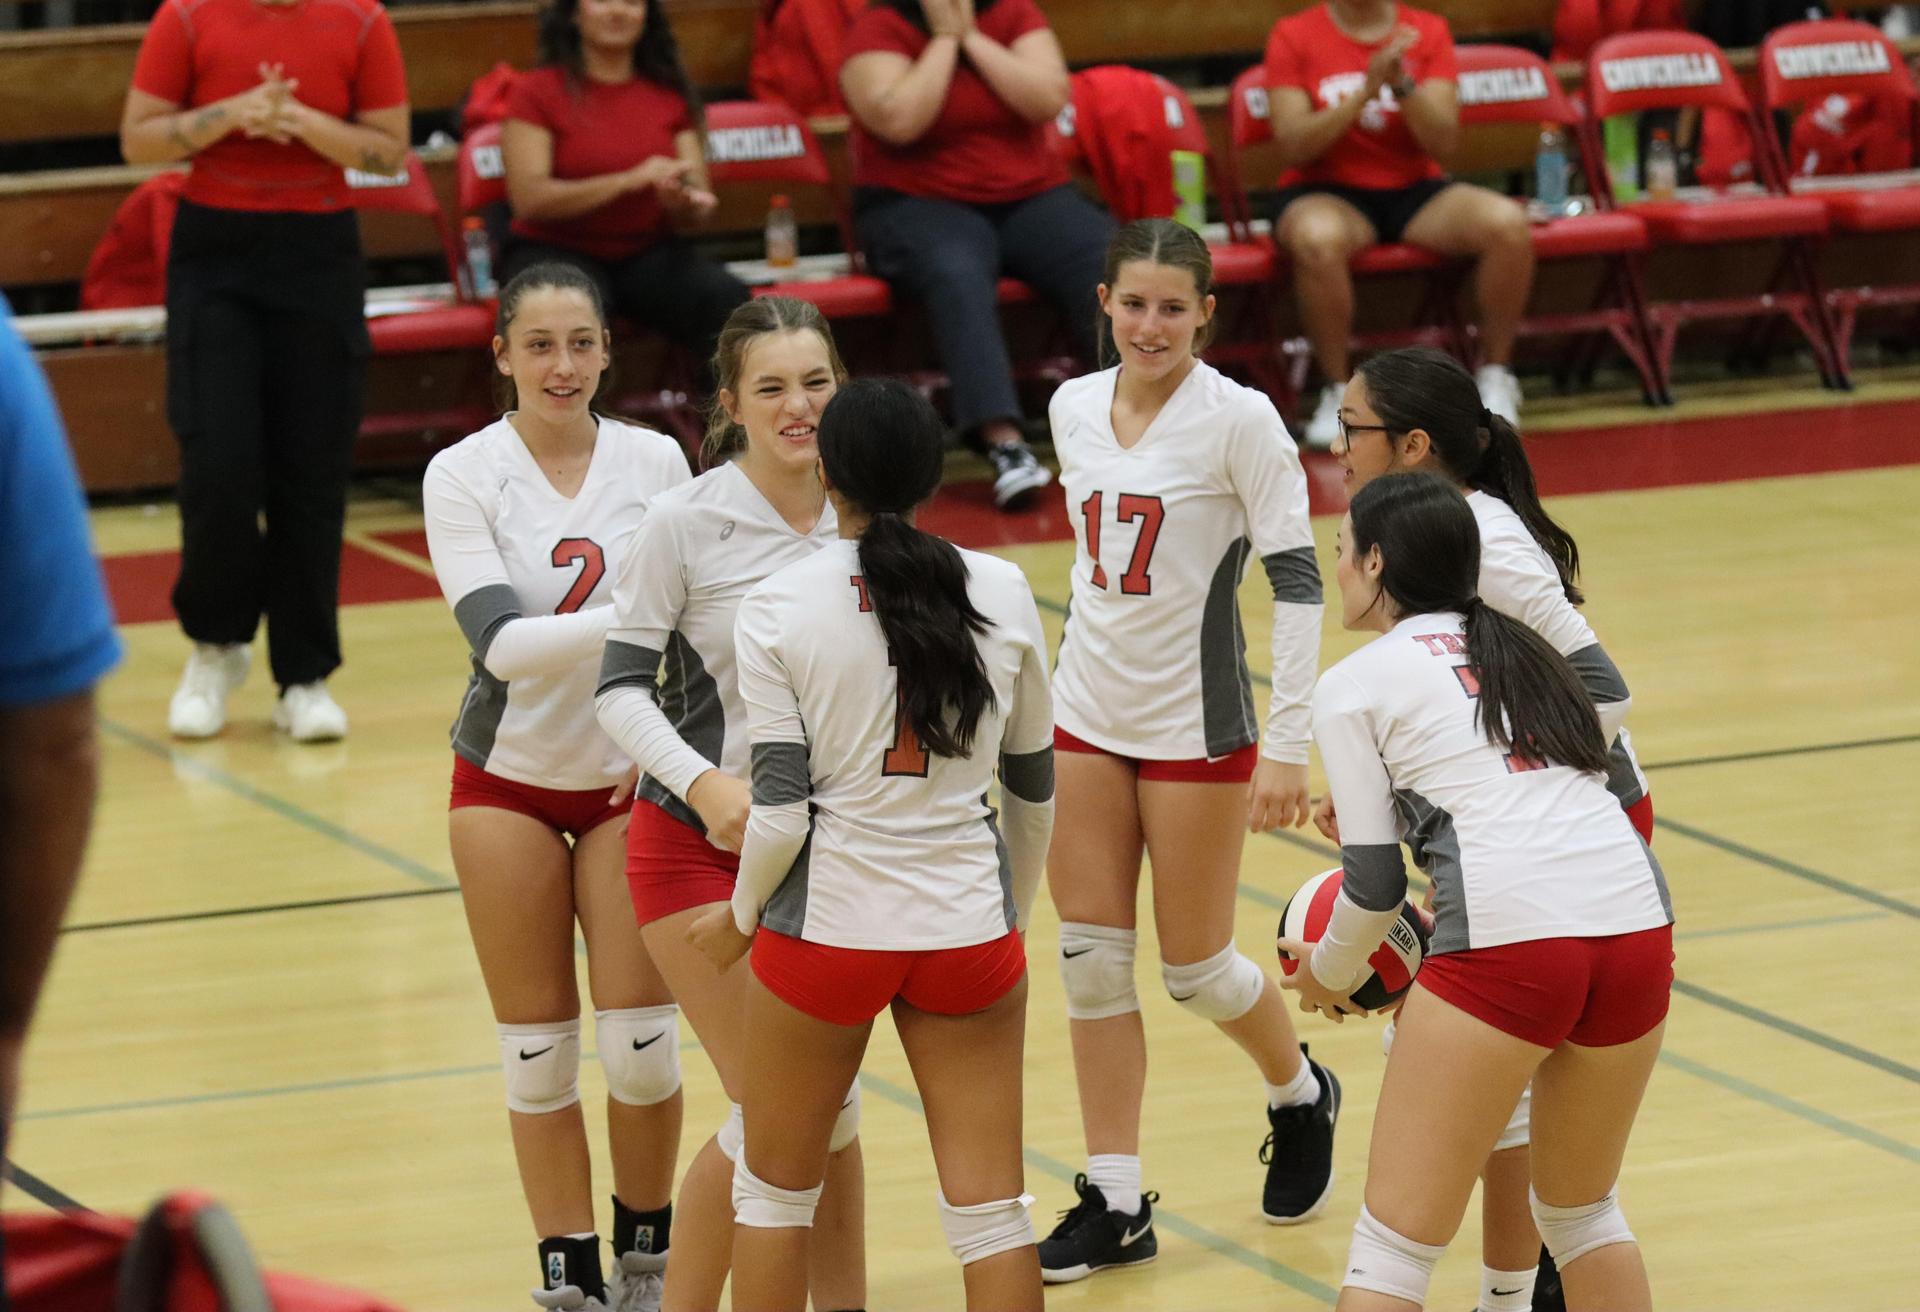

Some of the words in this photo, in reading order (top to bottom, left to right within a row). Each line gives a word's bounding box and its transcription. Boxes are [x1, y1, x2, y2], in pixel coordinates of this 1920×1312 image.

[551, 537, 606, 615] 2
[1081, 490, 1165, 596] 17
[1389, 920, 1414, 952] IKARA
